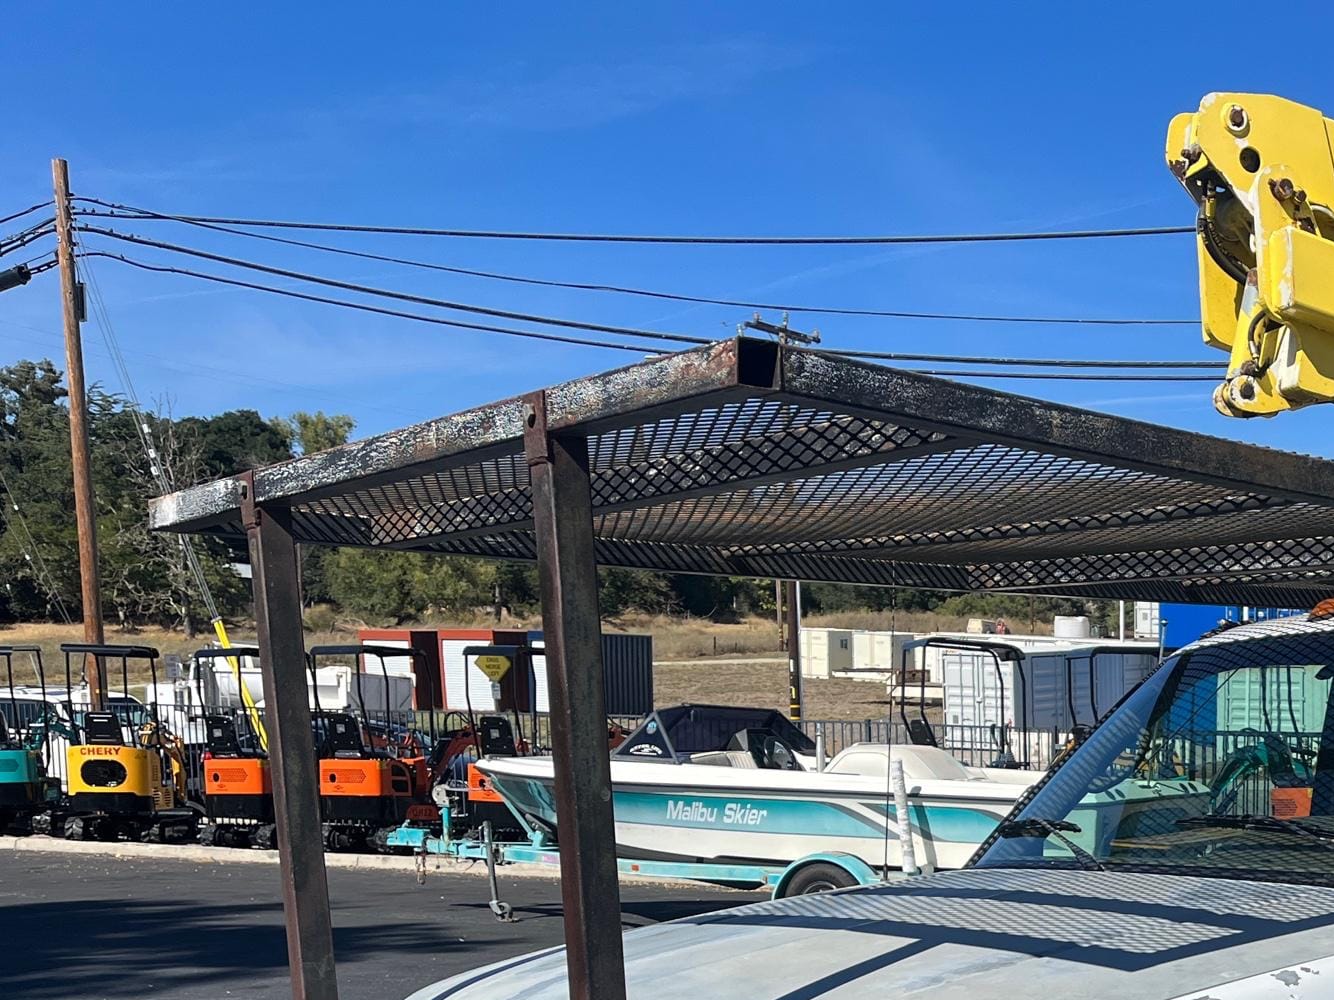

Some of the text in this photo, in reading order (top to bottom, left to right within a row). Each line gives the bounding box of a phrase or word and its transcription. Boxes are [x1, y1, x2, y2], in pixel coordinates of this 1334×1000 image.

[80, 747, 121, 756] CHERY
[666, 800, 768, 825] Malibu Skier
